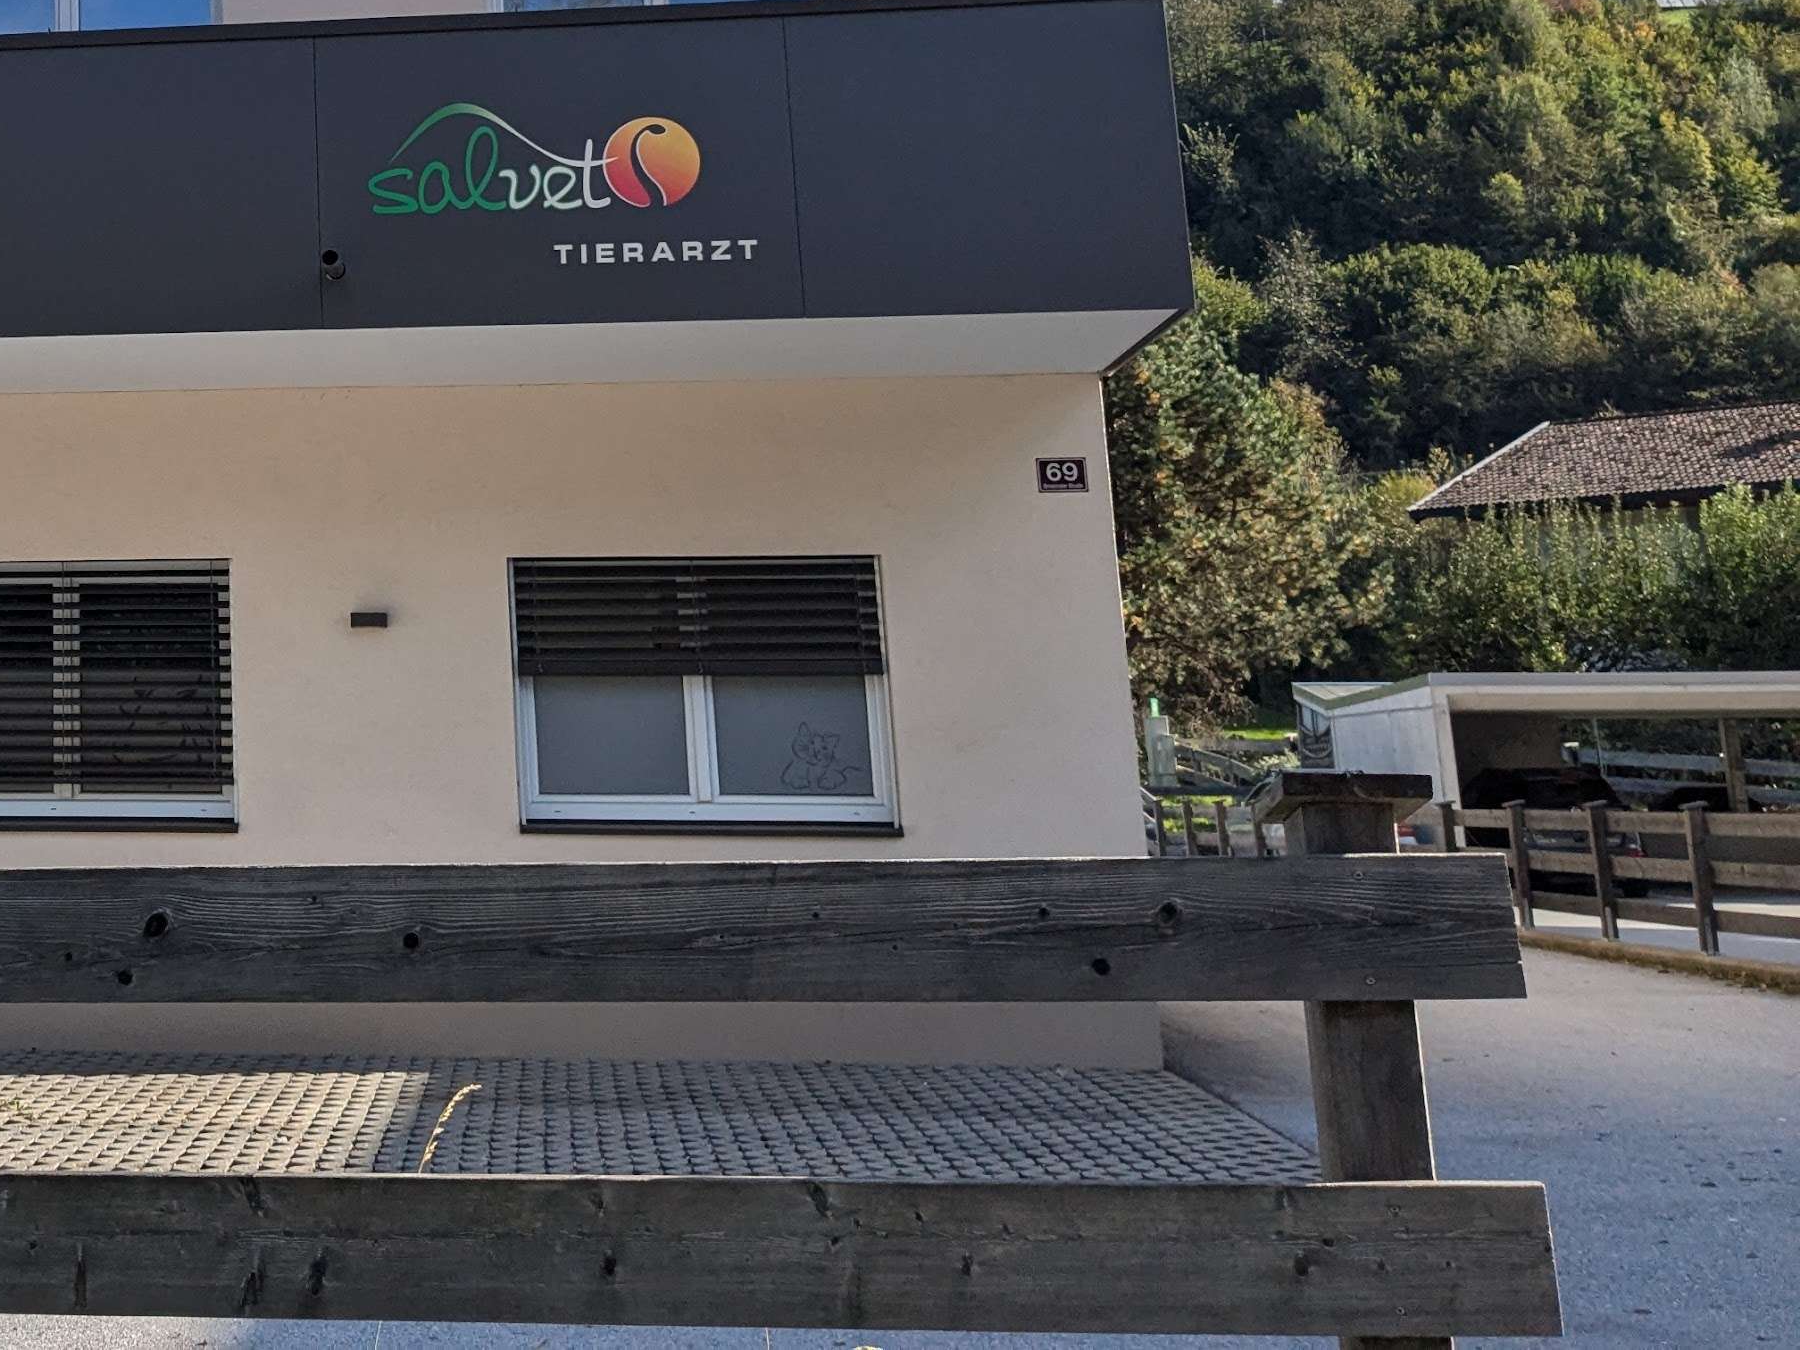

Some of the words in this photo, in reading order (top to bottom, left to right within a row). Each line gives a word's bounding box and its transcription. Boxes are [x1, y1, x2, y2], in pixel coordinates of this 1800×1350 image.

[368, 125, 611, 215] salvet
[553, 240, 758, 264] TIERARZT
[1047, 462, 1078, 482] 69
